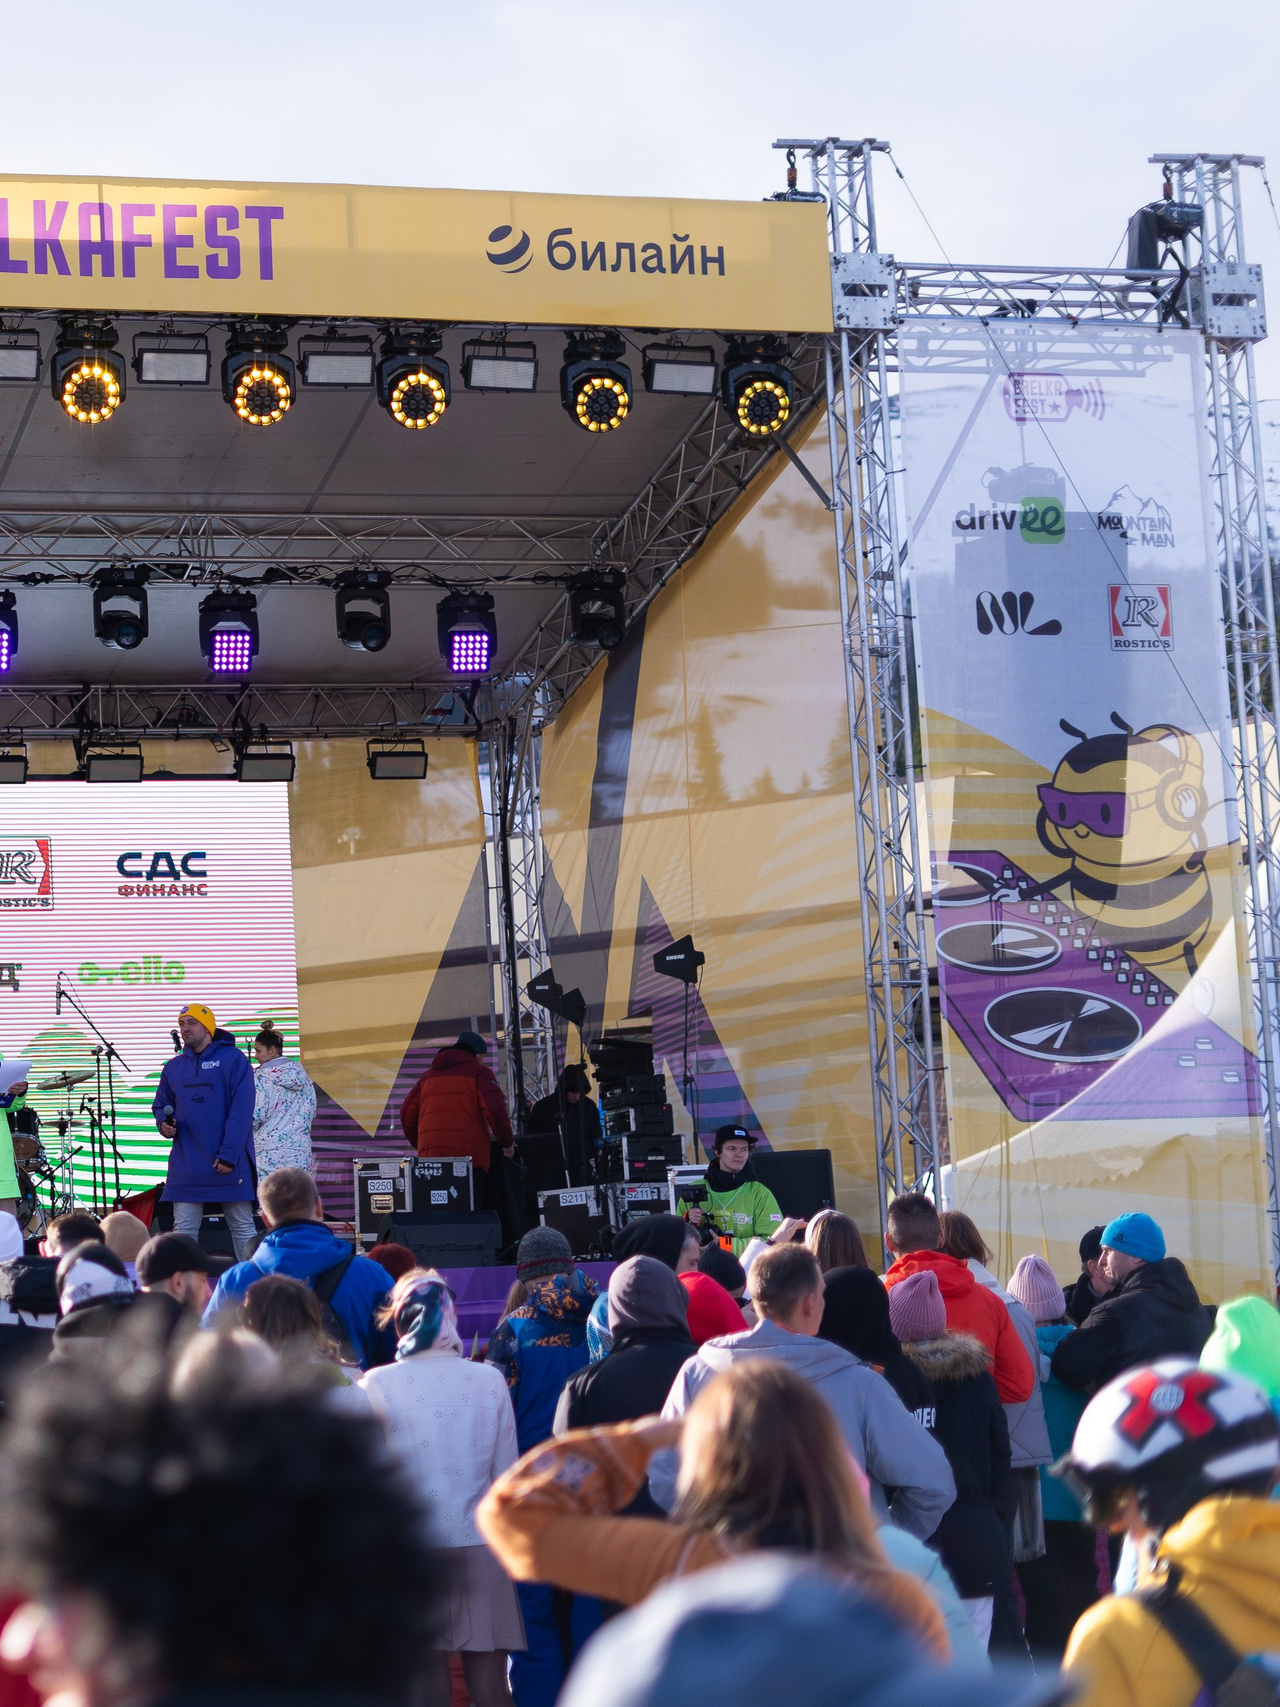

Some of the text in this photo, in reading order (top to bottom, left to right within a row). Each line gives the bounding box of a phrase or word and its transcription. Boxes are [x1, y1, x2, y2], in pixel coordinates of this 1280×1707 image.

[546, 227, 726, 277] билайн
[1013, 379, 1063, 397] GRELKA
[1014, 398, 1047, 415] FEST
[955, 502, 1066, 536] drivee
[1097, 513, 1173, 533] MOUNTAIN
[1141, 533, 1176, 548] MAN
[1114, 639, 1171, 649] ROSTIC'S
[116, 851, 208, 881] СДС
[117, 883, 208, 897] ФИНАНС
[370, 1181, 392, 1191] S250
[431, 1192, 447, 1203] S250
[561, 1194, 584, 1205] S211
[626, 1190, 650, 1200] S211
